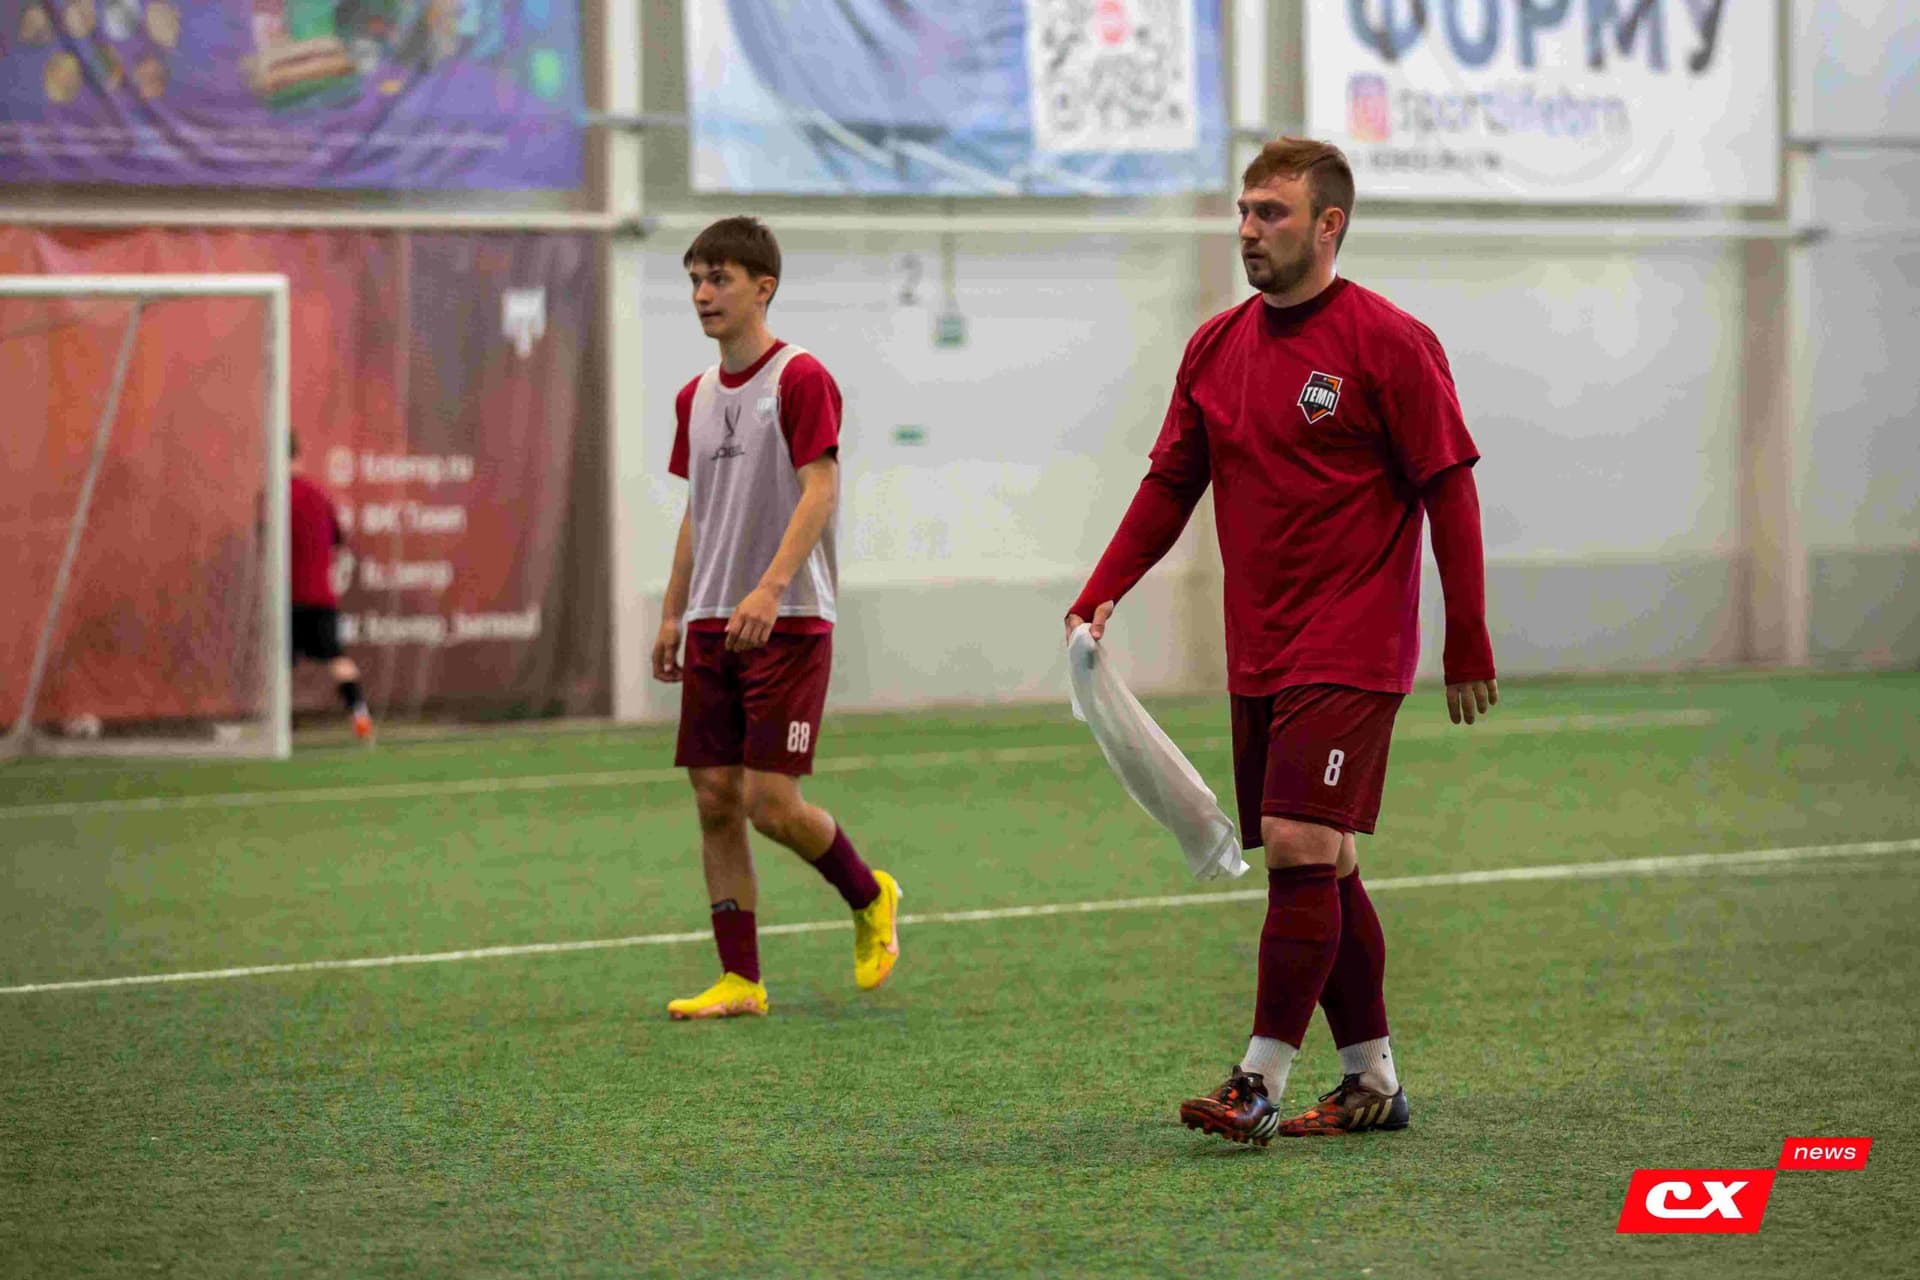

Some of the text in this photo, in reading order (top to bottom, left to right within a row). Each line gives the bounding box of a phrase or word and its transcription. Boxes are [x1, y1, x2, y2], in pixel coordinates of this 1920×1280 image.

[1303, 386, 1336, 409] ТЕМП
[787, 721, 810, 753] 88
[1324, 749, 1345, 786] 8
